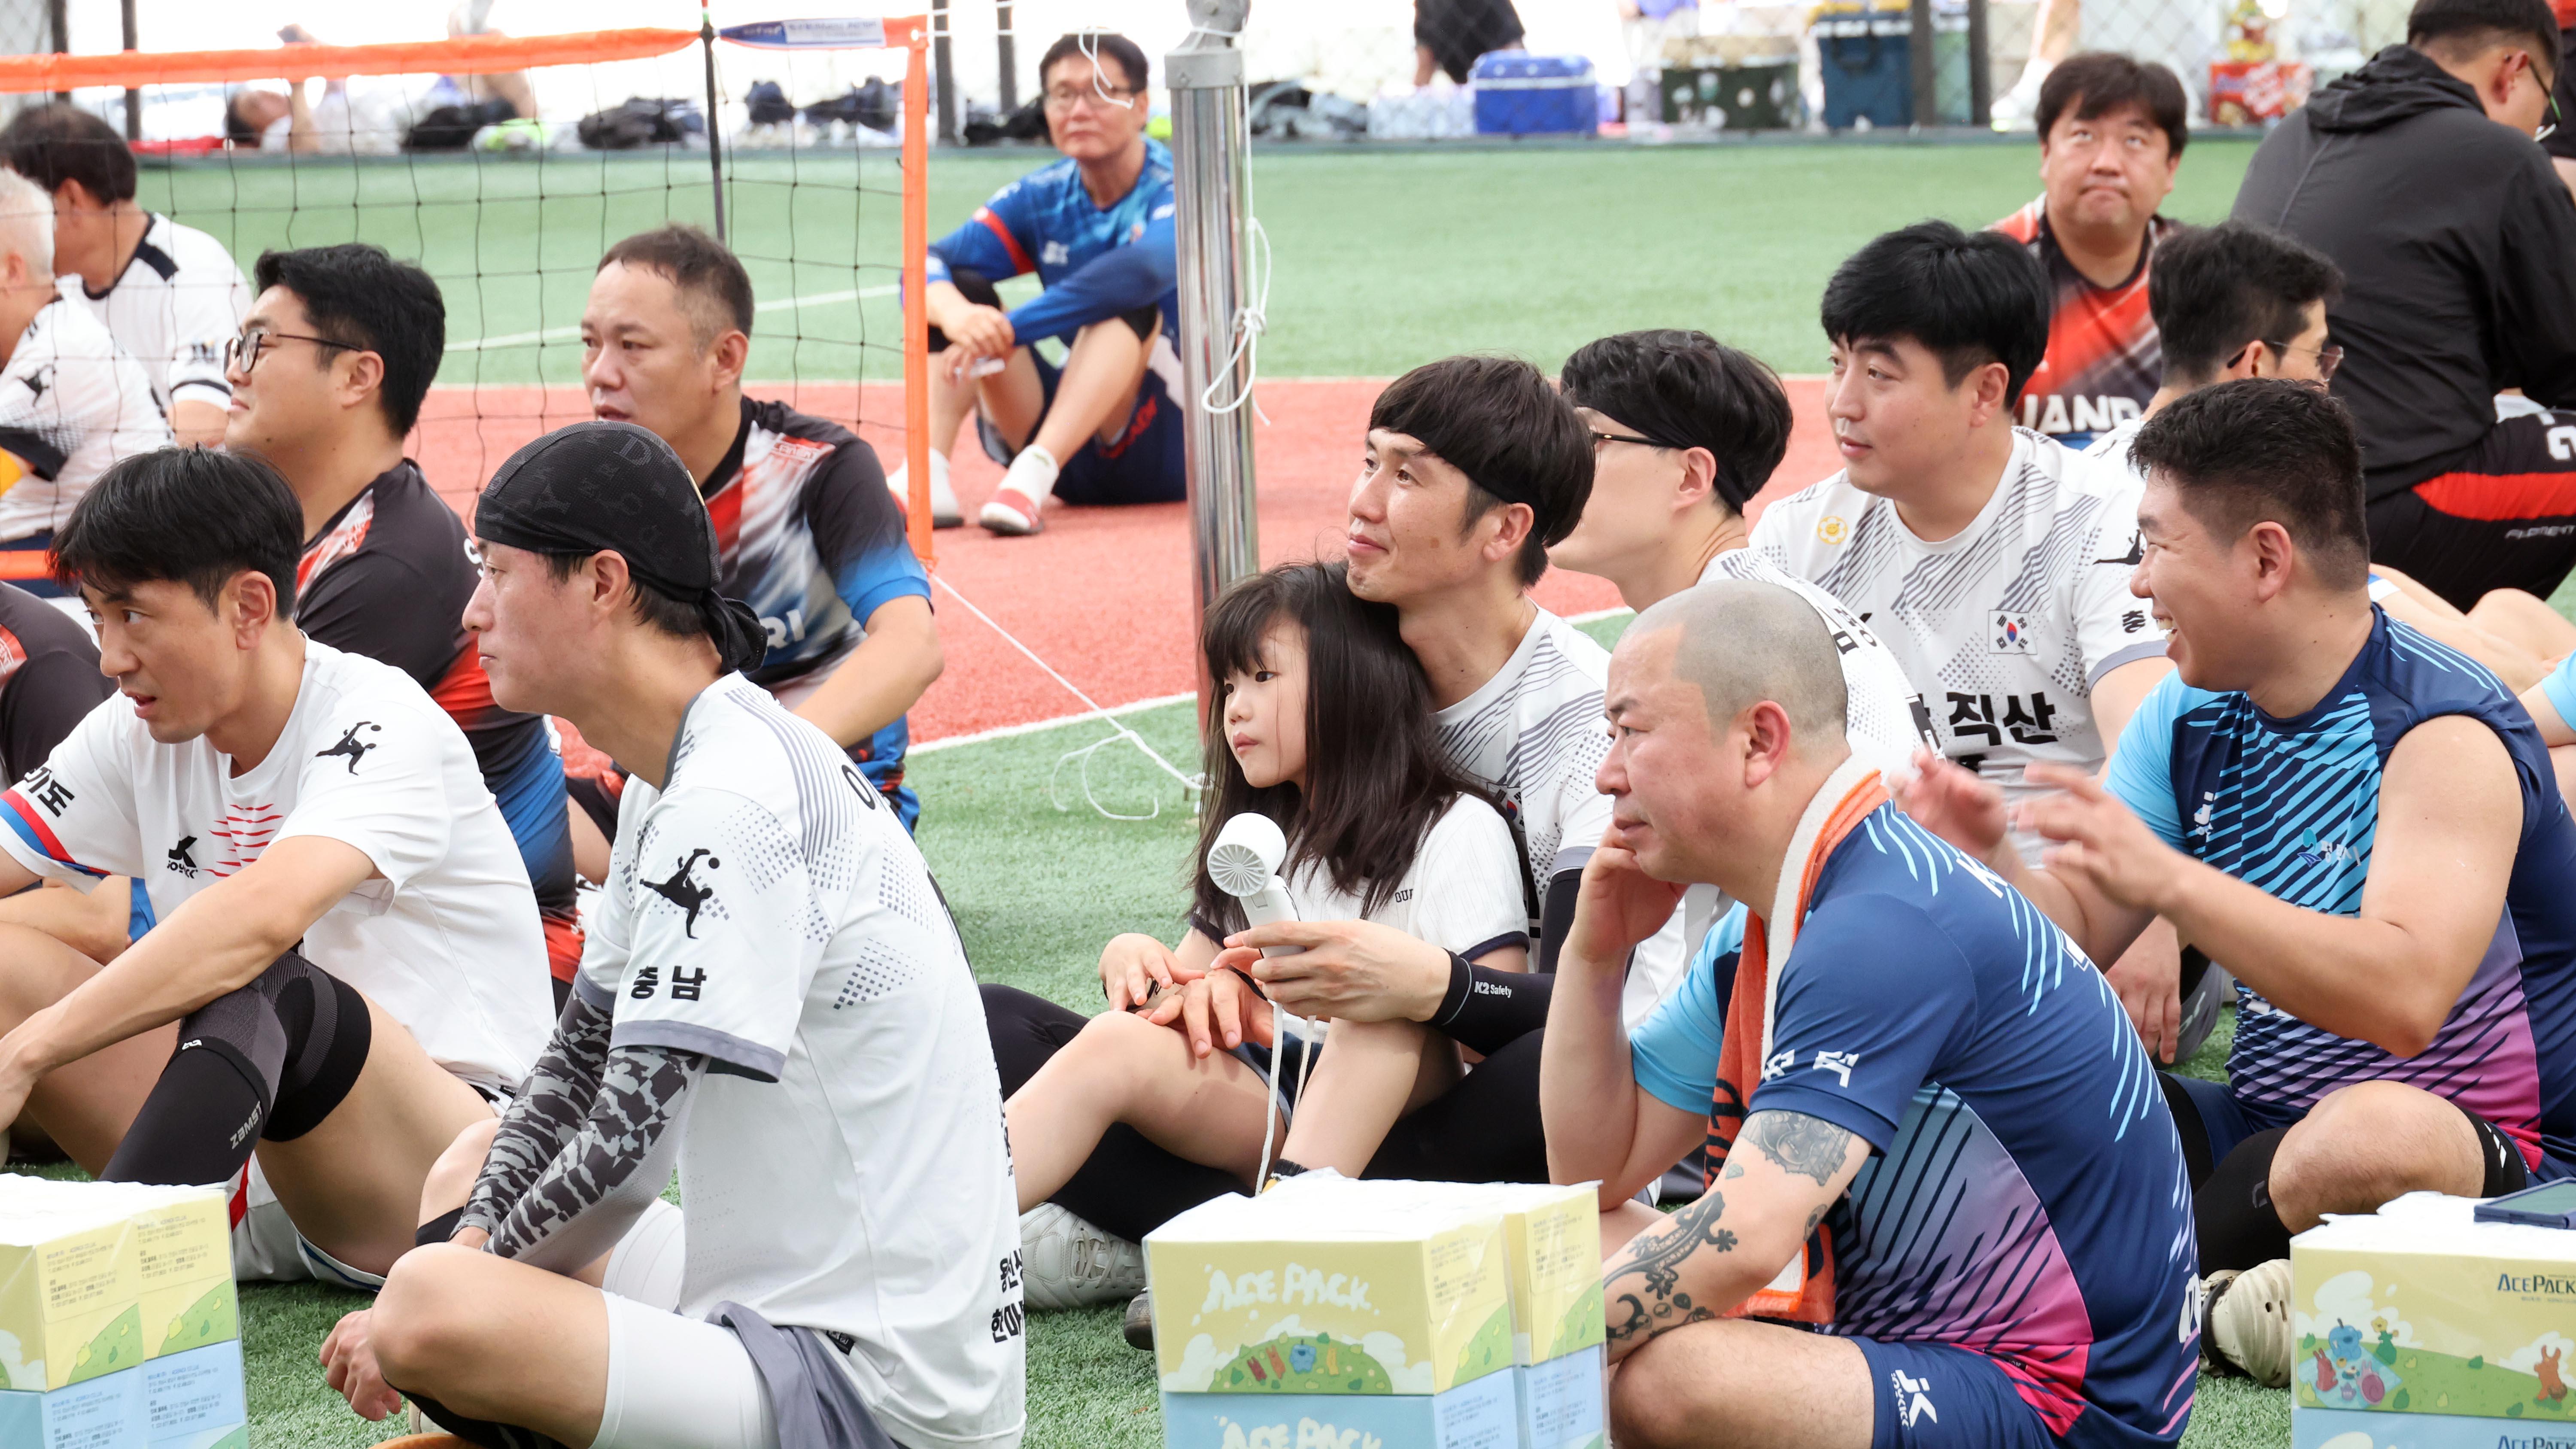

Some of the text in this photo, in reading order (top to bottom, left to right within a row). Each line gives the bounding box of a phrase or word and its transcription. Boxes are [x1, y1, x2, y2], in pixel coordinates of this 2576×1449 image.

[1947, 692, 2058, 746] 직산
[24, 766, 75, 818] 기도
[631, 965, 707, 1001] 충남
[1474, 981, 1512, 998] K2 Safety
